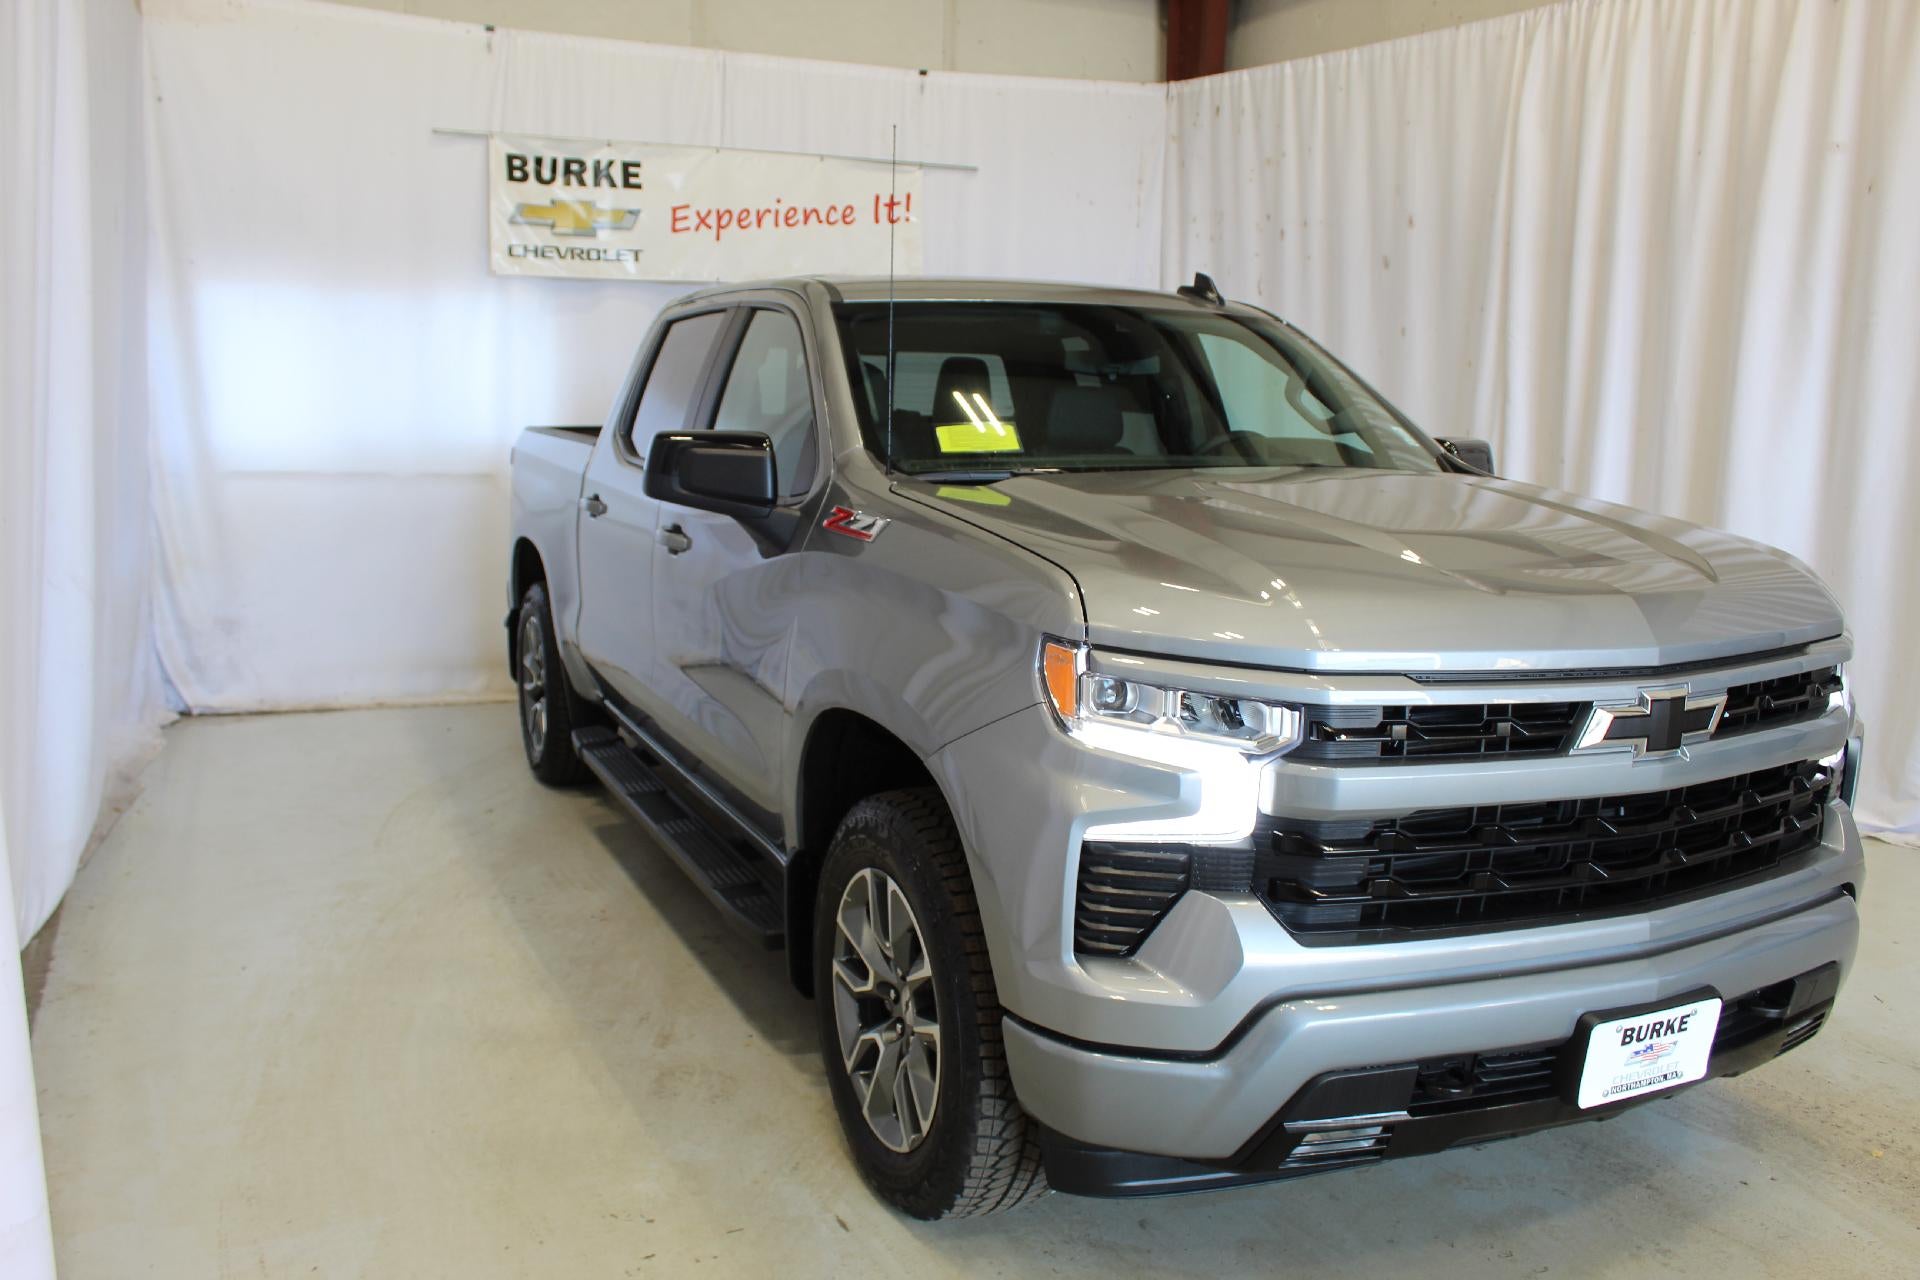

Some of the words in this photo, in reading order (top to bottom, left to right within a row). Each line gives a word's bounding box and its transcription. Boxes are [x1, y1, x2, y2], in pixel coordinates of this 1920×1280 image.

[506, 152, 642, 190] BURKE
[670, 198, 856, 241] Experience
[873, 193, 912, 225] It!
[507, 243, 643, 262] CHEVROLET
[1620, 1013, 1691, 1046] BURKE
[1611, 1061, 1680, 1085] CHEVROLET
